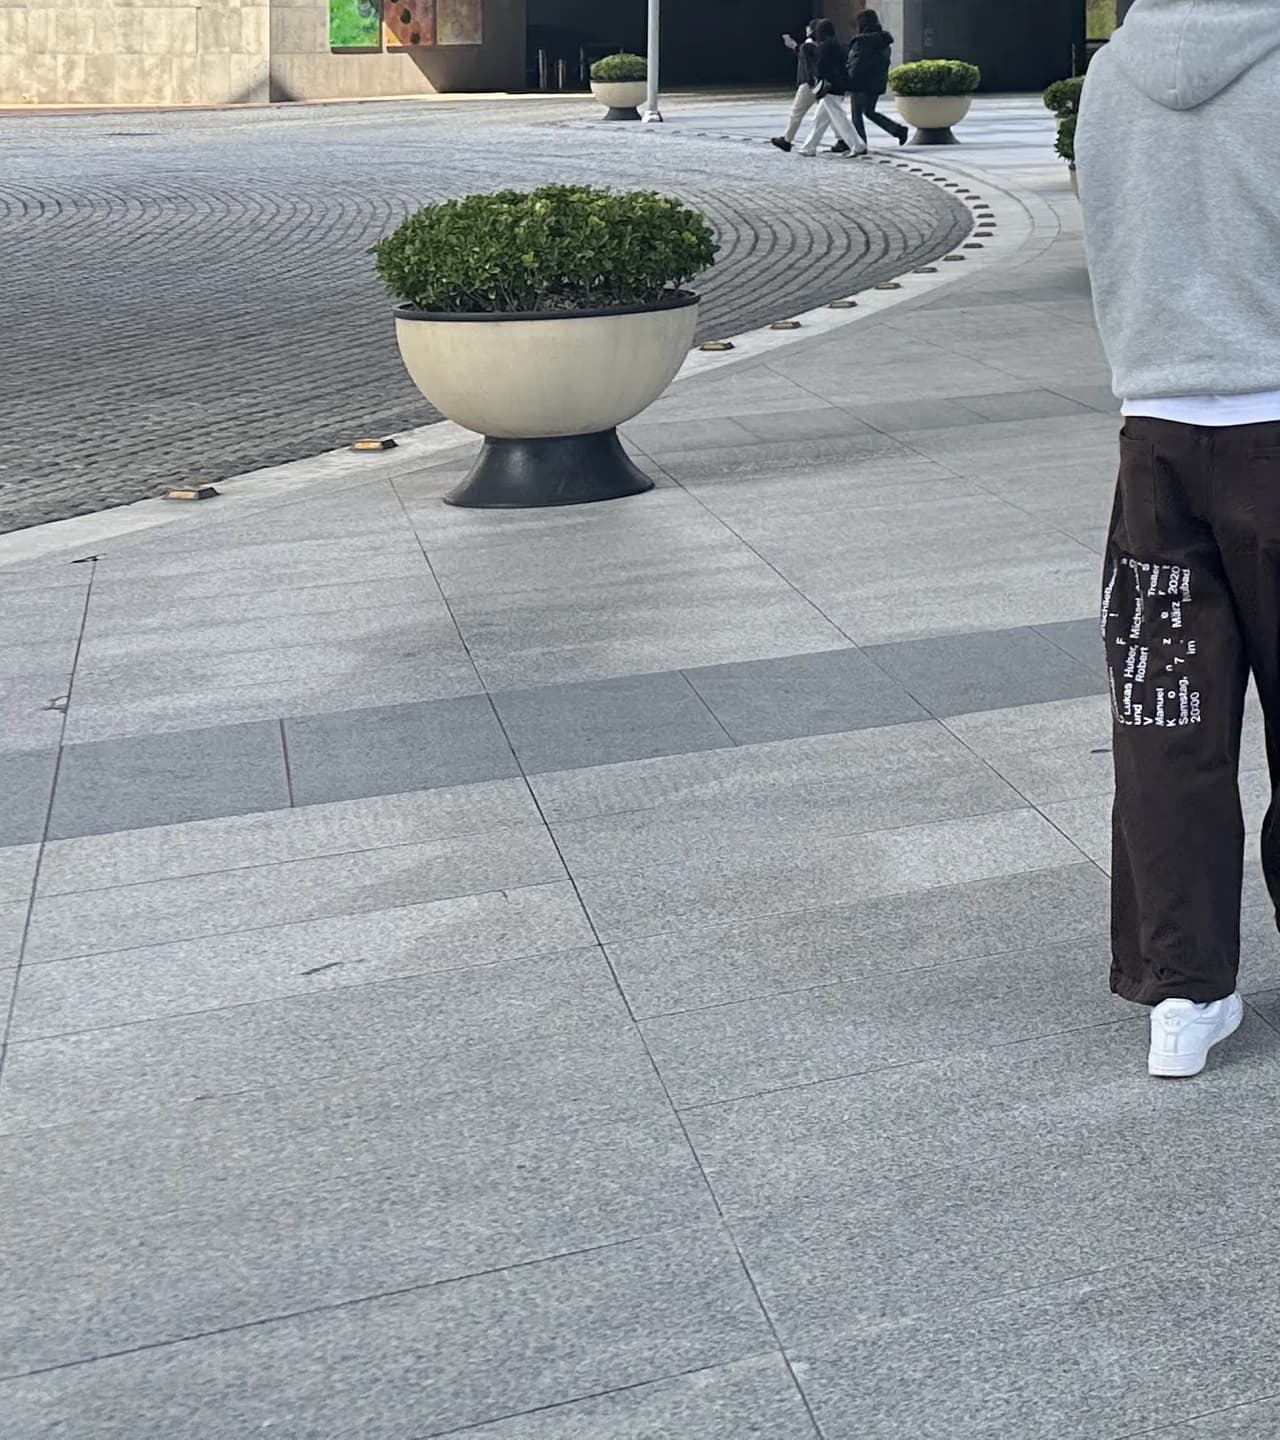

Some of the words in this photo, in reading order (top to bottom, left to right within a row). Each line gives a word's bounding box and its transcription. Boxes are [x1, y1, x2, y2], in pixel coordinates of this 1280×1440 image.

[1168, 566, 1180, 594] 2020
[1129, 598, 1141, 638] Michael
[1171, 601, 1182, 628] März
[1124, 645, 1139, 678] Huber,
[1187, 640, 1196, 655] im
[1135, 646, 1148, 682] Robert
[1123, 683, 1132, 715] Lukas
[1133, 704, 1142, 725] und
[1155, 688, 1164, 726] Manuel
[1178, 676, 1189, 725] Samstag,
[1190, 692, 1200, 723] 20:00
